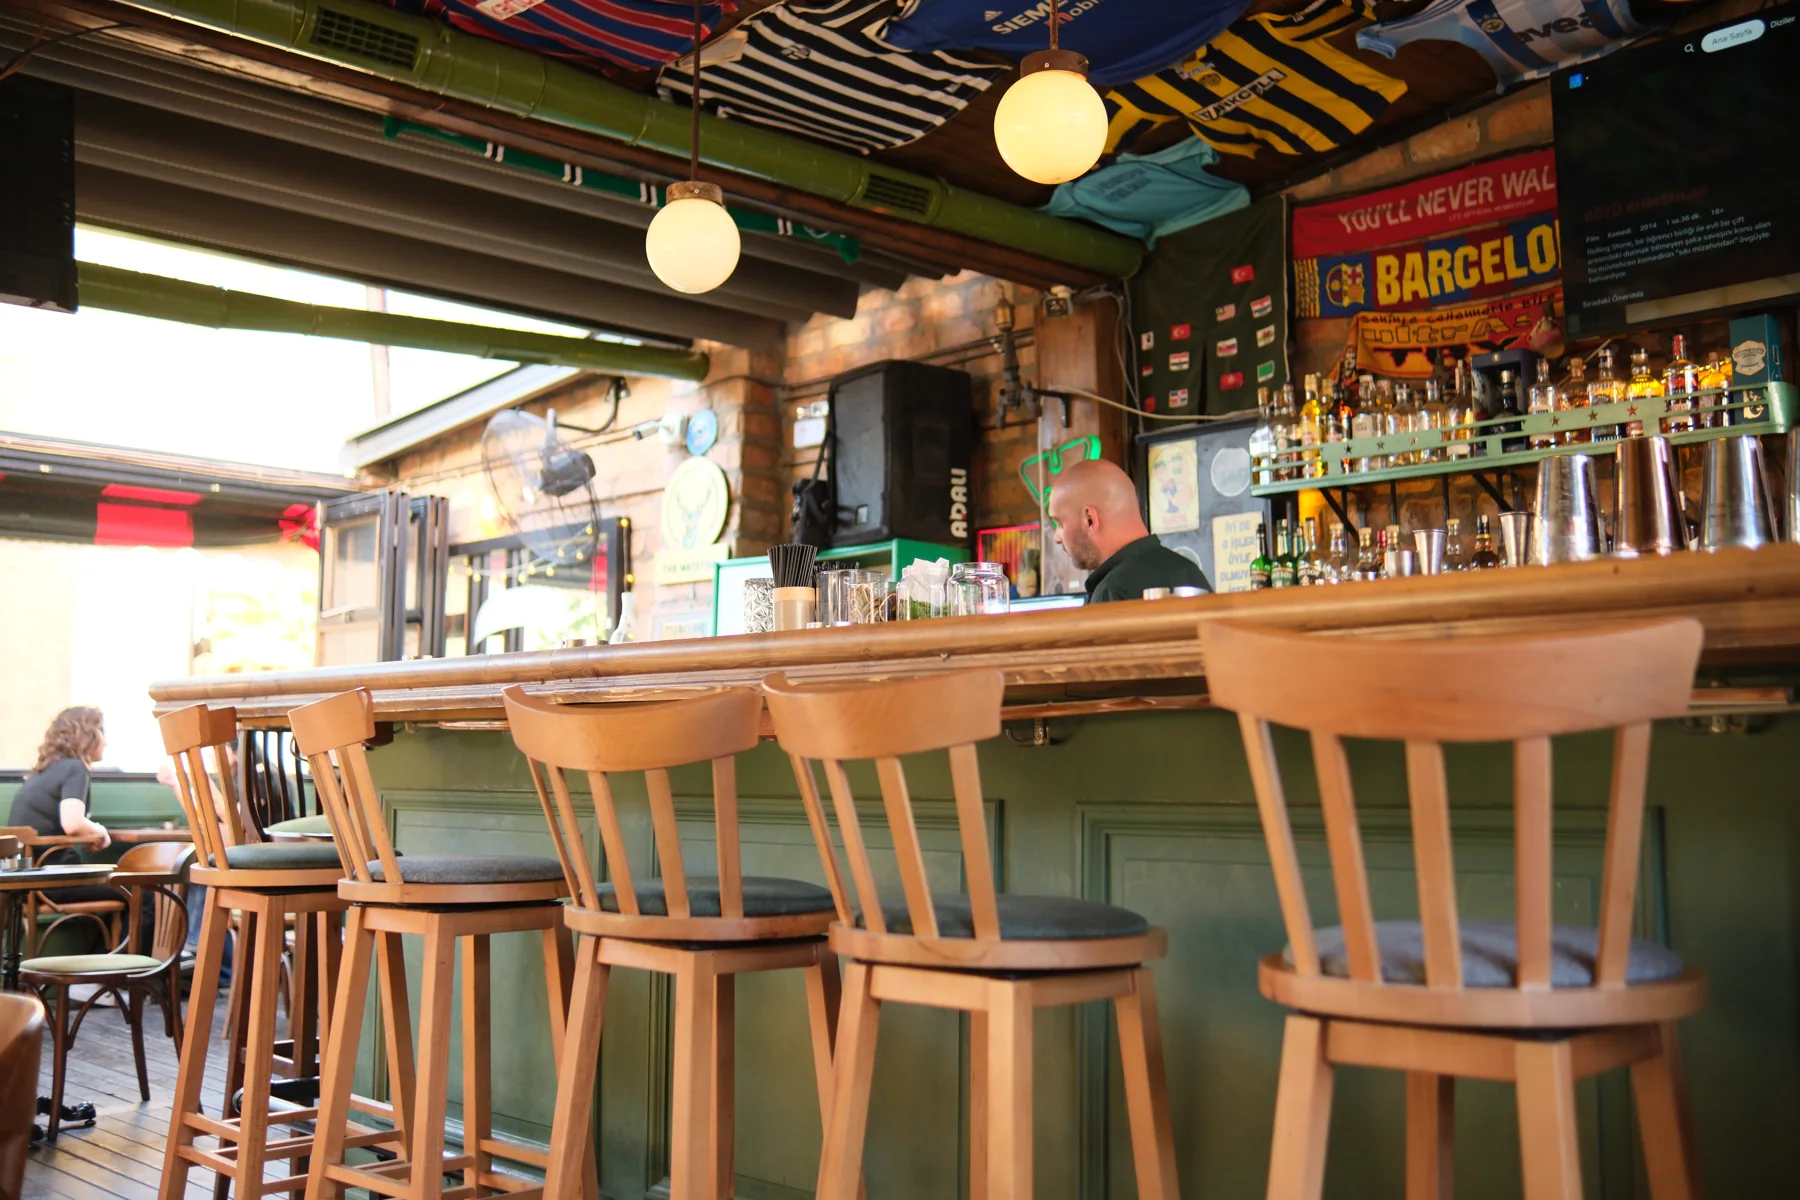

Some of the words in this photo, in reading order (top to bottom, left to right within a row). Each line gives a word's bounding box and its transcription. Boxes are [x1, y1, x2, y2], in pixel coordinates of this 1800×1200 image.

[1711, 36, 1728, 46] Ana
[1729, 28, 1753, 41] Sayfa
[1770, 15, 1797, 28] Diziler
[1338, 199, 1411, 234] YOU'LL
[1416, 176, 1494, 219] NEVER
[1587, 246, 1610, 257] Rolling
[1612, 240, 1634, 251] Stone,
[1635, 237, 1645, 246] bir
[1645, 231, 1673, 244] öğrenci
[1673, 227, 1694, 239] birliği
[1705, 221, 1719, 231] evli
[1720, 219, 1731, 228] bir
[1732, 215, 1745, 226] çift
[1588, 252, 1622, 265] arasındaki
[1623, 247, 1649, 258] durmak
[1651, 239, 1684, 252] bilmeyen
[1684, 235, 1702, 246] şaka
[1703, 229, 1733, 242] savaşını
[1734, 224, 1753, 234] konu
[1753, 220, 1771, 231] alan
[1607, 228, 1632, 238] Komedi
[1639, 222, 1658, 232] 2014
[1376, 219, 1562, 307] BARCELO
[1588, 266, 1597, 274] bu
[1598, 258, 1636, 272] müstehcen
[1637, 250, 1675, 265] komedinin
[1739, 231, 1770, 244] övgüyle
[1611, 290, 1645, 303] Önerimiz
[949, 467, 968, 538] ADALI
